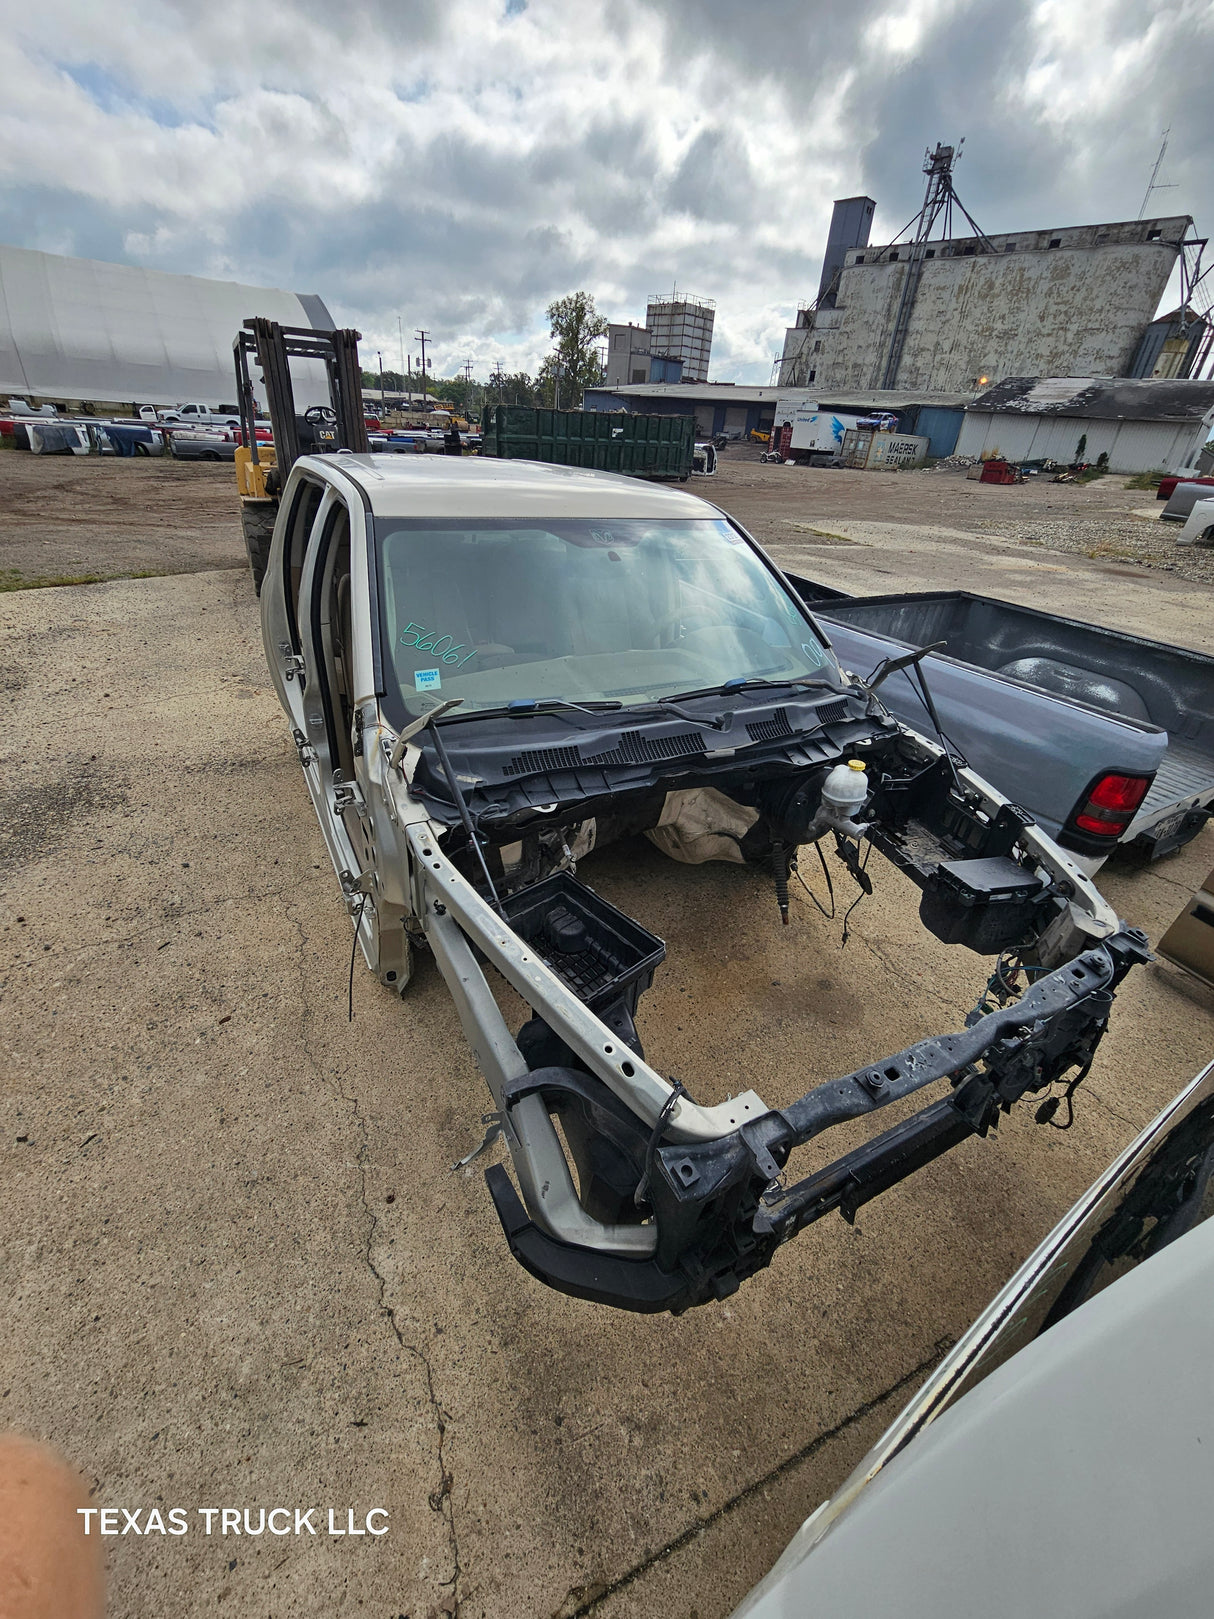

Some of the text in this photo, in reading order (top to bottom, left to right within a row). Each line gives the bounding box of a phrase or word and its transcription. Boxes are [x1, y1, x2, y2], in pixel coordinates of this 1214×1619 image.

[319, 430, 335, 439] CAT
[888, 441, 919, 455] MAERSK
[399, 622, 478, 668] 56061
